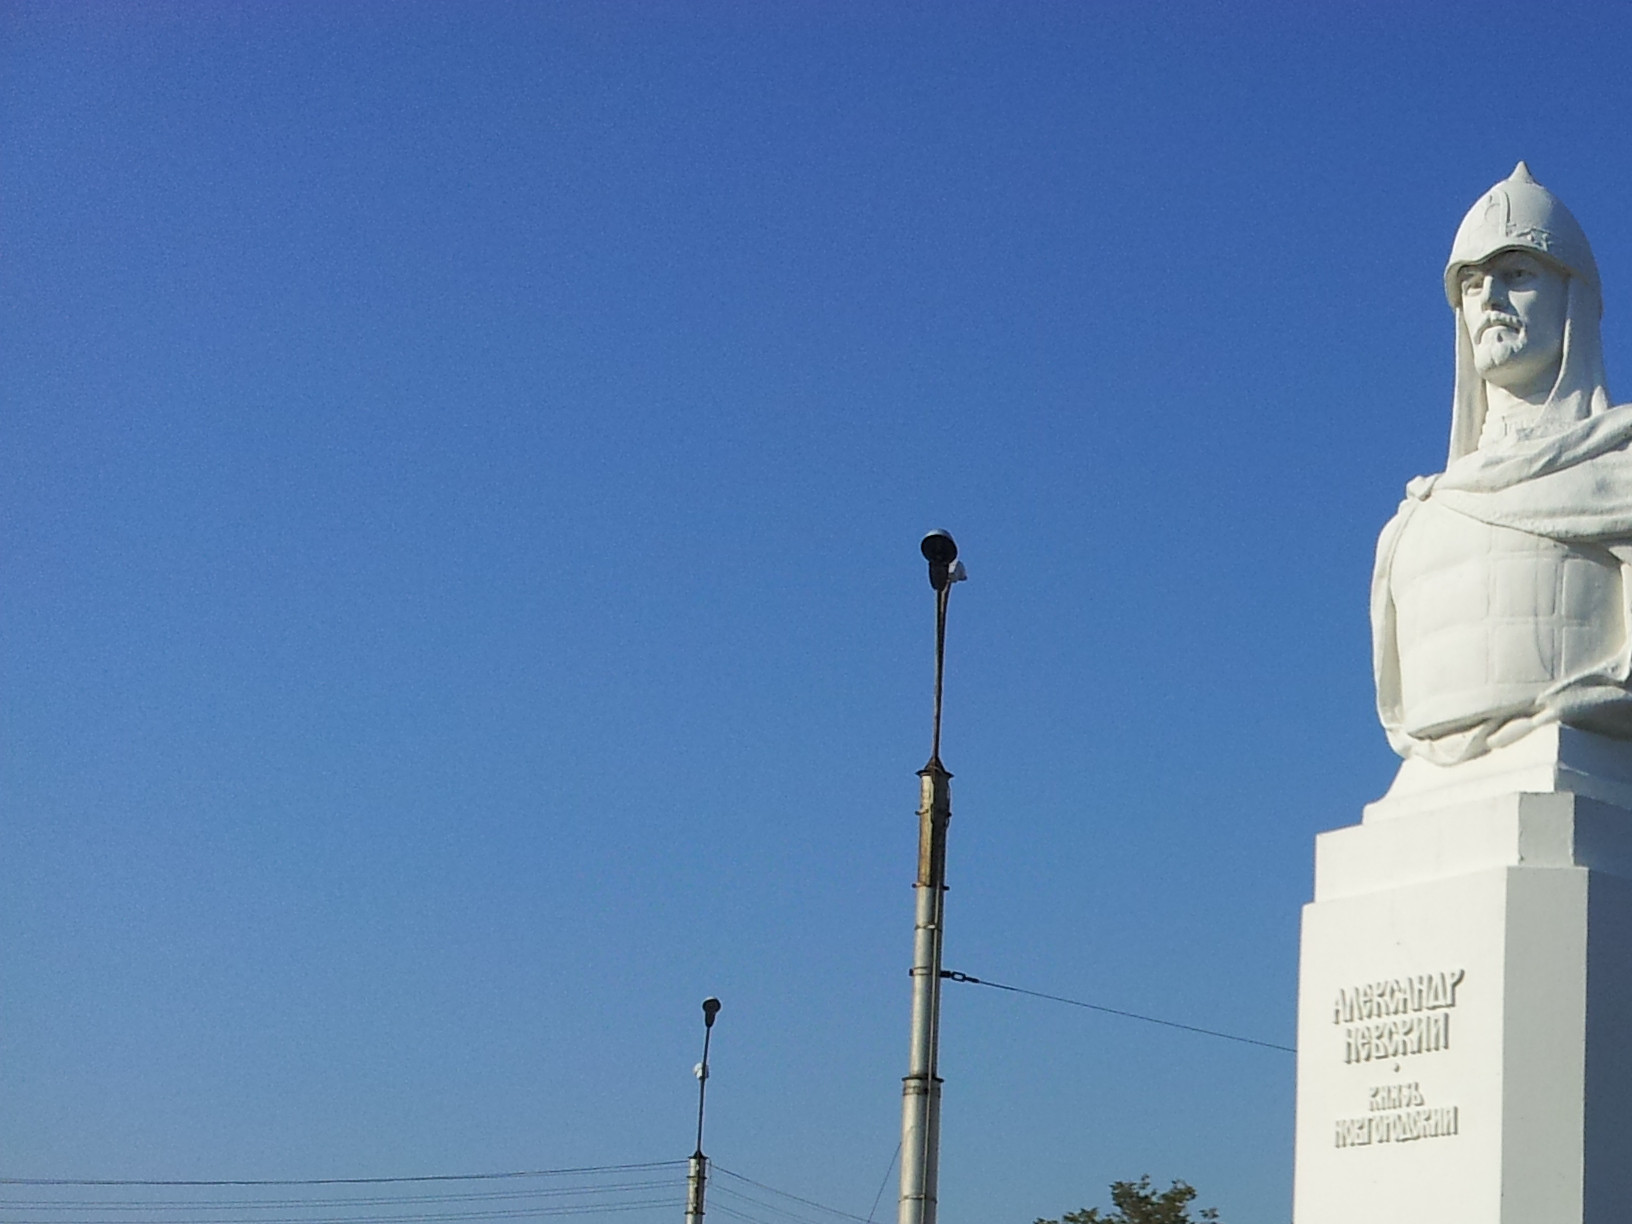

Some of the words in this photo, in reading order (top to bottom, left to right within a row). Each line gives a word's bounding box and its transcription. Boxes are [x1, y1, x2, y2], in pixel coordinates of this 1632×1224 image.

[1332, 968, 1465, 1025] АЛЕКСАНДР
[1344, 1012, 1449, 1064] НЕВСКИЙ
[1368, 1080, 1425, 1111] КНЯЗЬ
